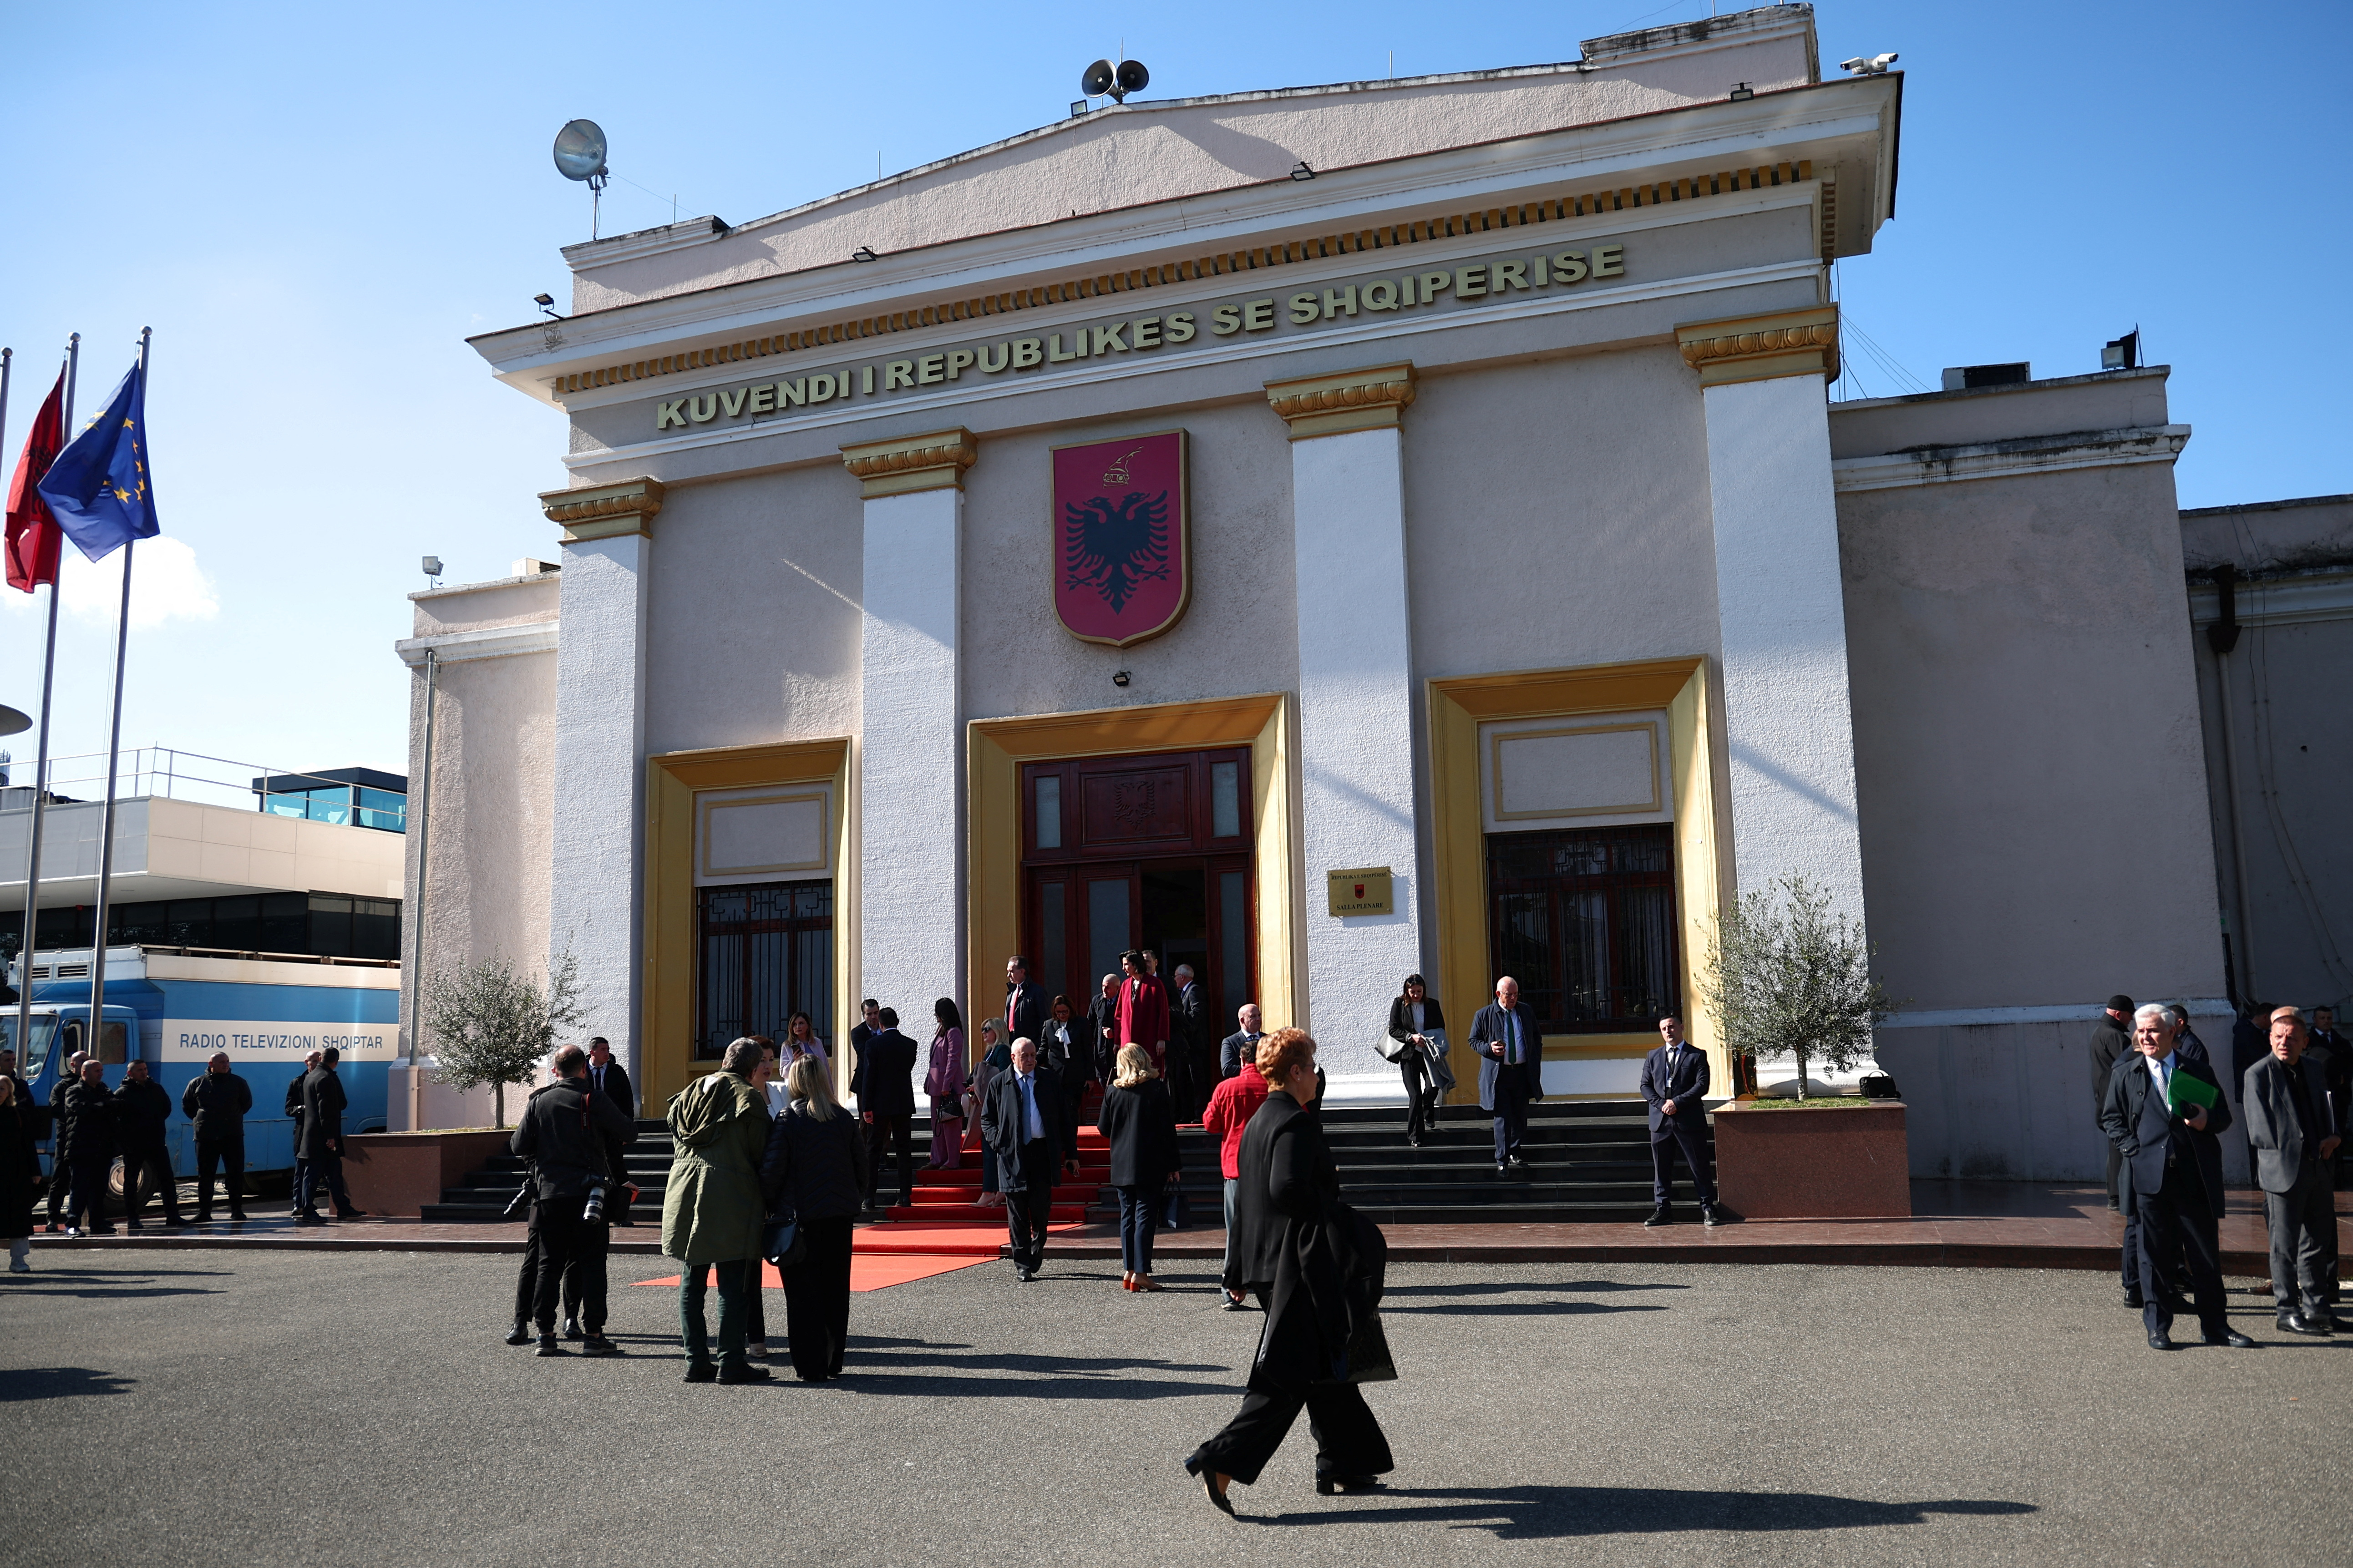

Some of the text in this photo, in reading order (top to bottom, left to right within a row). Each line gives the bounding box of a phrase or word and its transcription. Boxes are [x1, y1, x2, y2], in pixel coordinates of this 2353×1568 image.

[657, 243, 1624, 430] KUVENDI I REPUBLIKES SE SHQIPERISE
[180, 1034, 382, 1050] RADIO TELEVIZIONI SHQIPTAR
